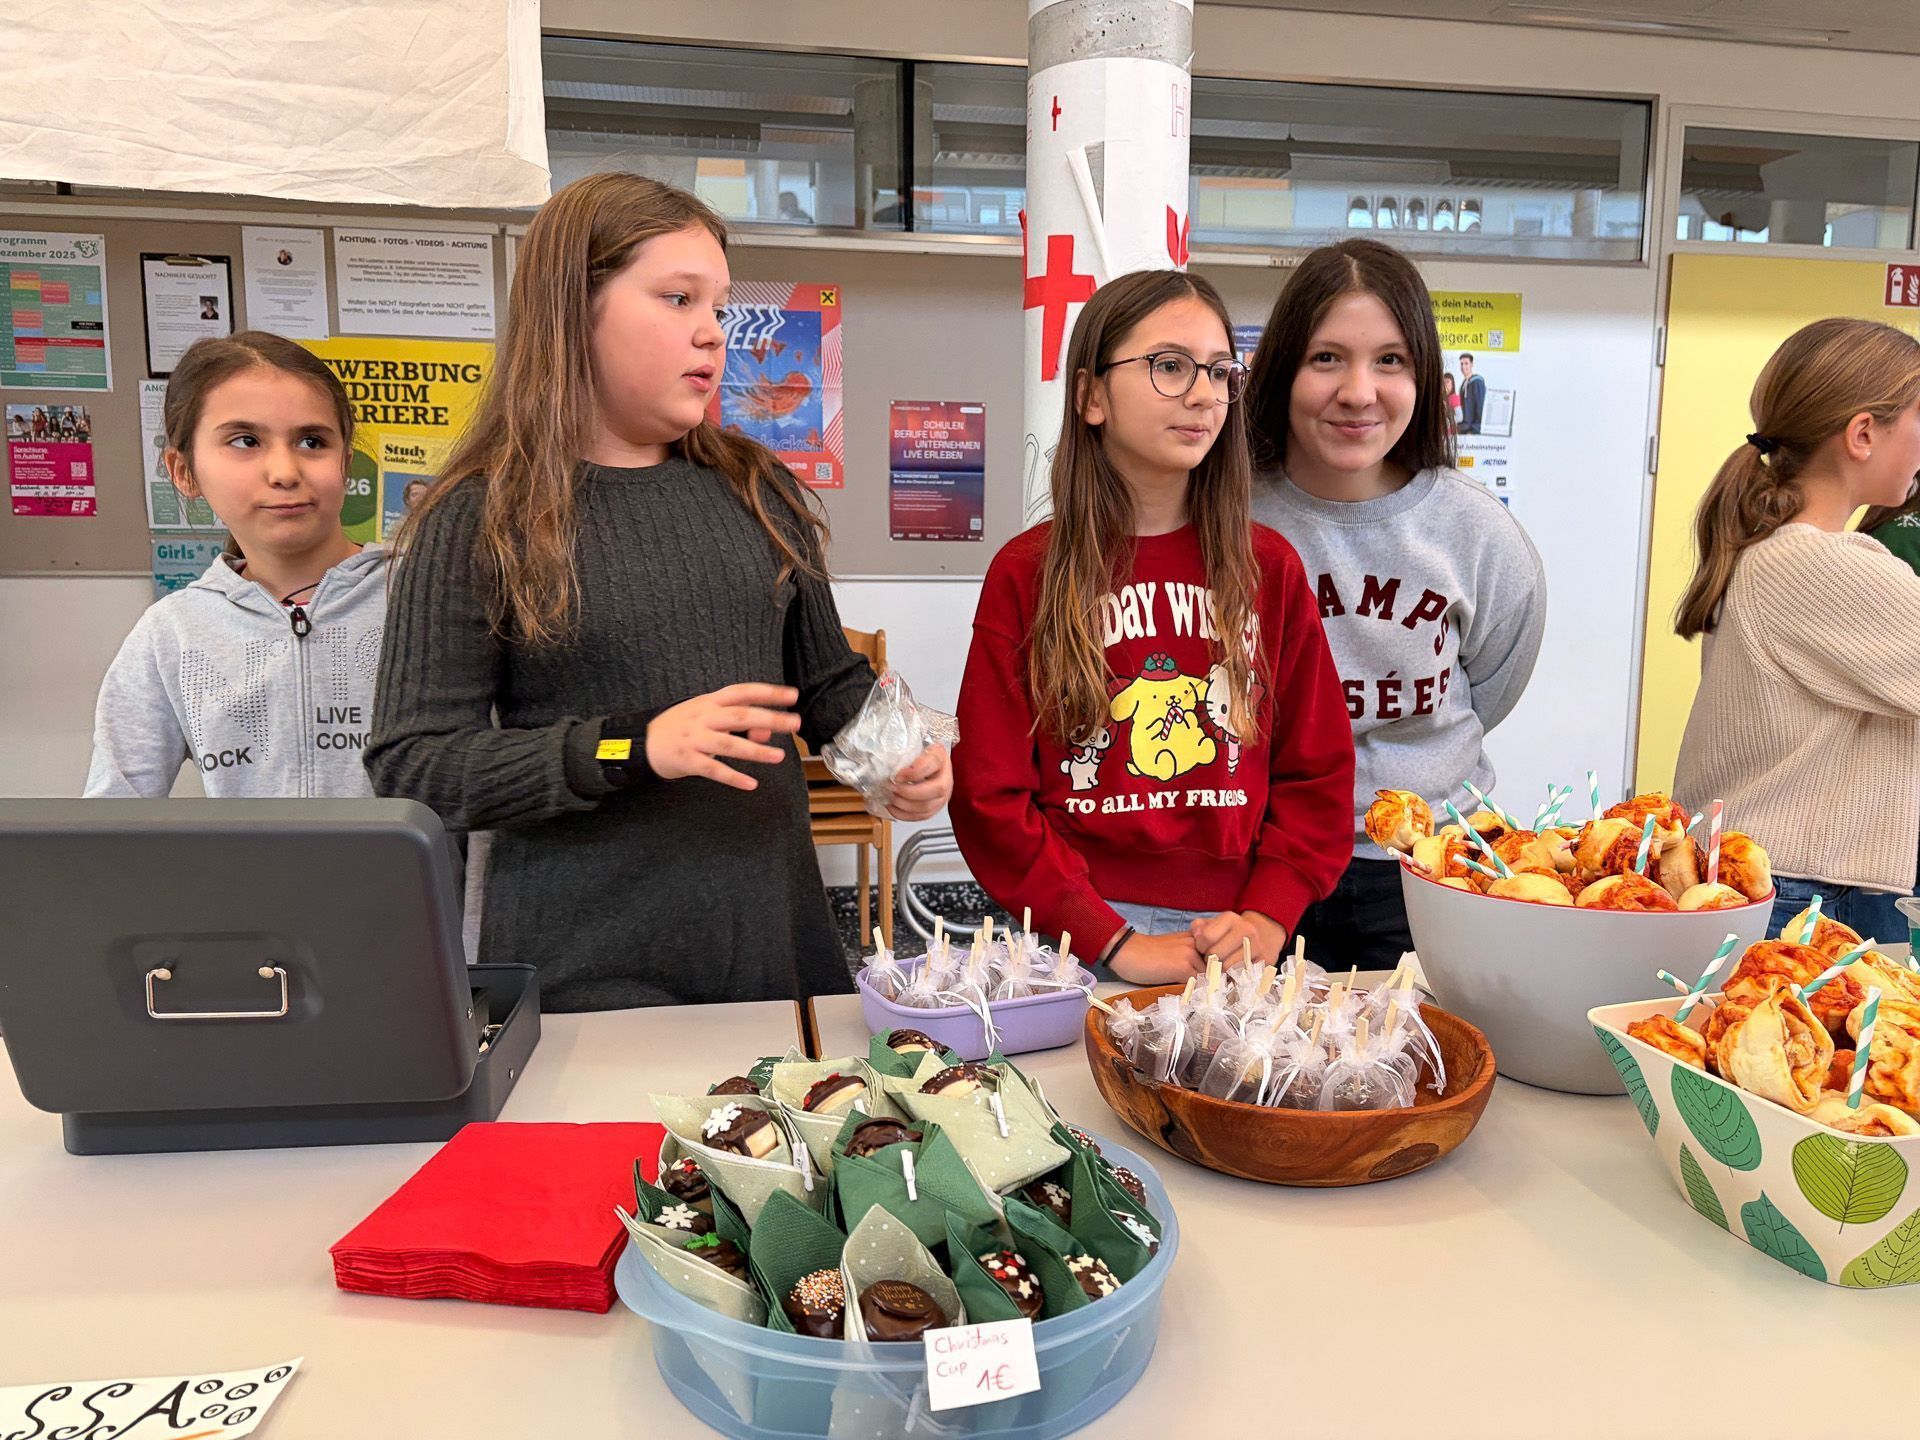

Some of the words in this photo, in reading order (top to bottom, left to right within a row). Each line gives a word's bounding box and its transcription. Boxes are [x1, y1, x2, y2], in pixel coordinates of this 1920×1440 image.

[338, 235, 376, 245] ACHTUNG
[382, 237, 408, 246] FOTOS
[414, 239, 444, 248] VIDEOS
[450, 241, 487, 250] ACHTUNG
[49, 250, 76, 259] 2025
[1442, 300, 1462, 308] dein
[1464, 300, 1494, 309] Match,
[321, 359, 482, 384] WERBUNG
[344, 382, 430, 404] DIUM
[923, 420, 965, 430] SCHULEN
[894, 429, 928, 438] BERUFE
[930, 430, 950, 439] UND
[384, 444, 426, 460] Study
[915, 440, 980, 450] UNTERNEHMEN
[384, 456, 408, 464] Guide
[903, 450, 922, 459] LIVE
[924, 450, 964, 460] ERLEBEN
[71, 500, 90, 513] EF
[316, 707, 362, 724] LIVE
[200, 746, 252, 774] OCK
[1064, 798, 1096, 814] TO
[1148, 790, 1180, 809] MY
[934, 1326, 1008, 1354] Christmas
[936, 1362, 968, 1378] Cup
[976, 1364, 1014, 1392] 1€
